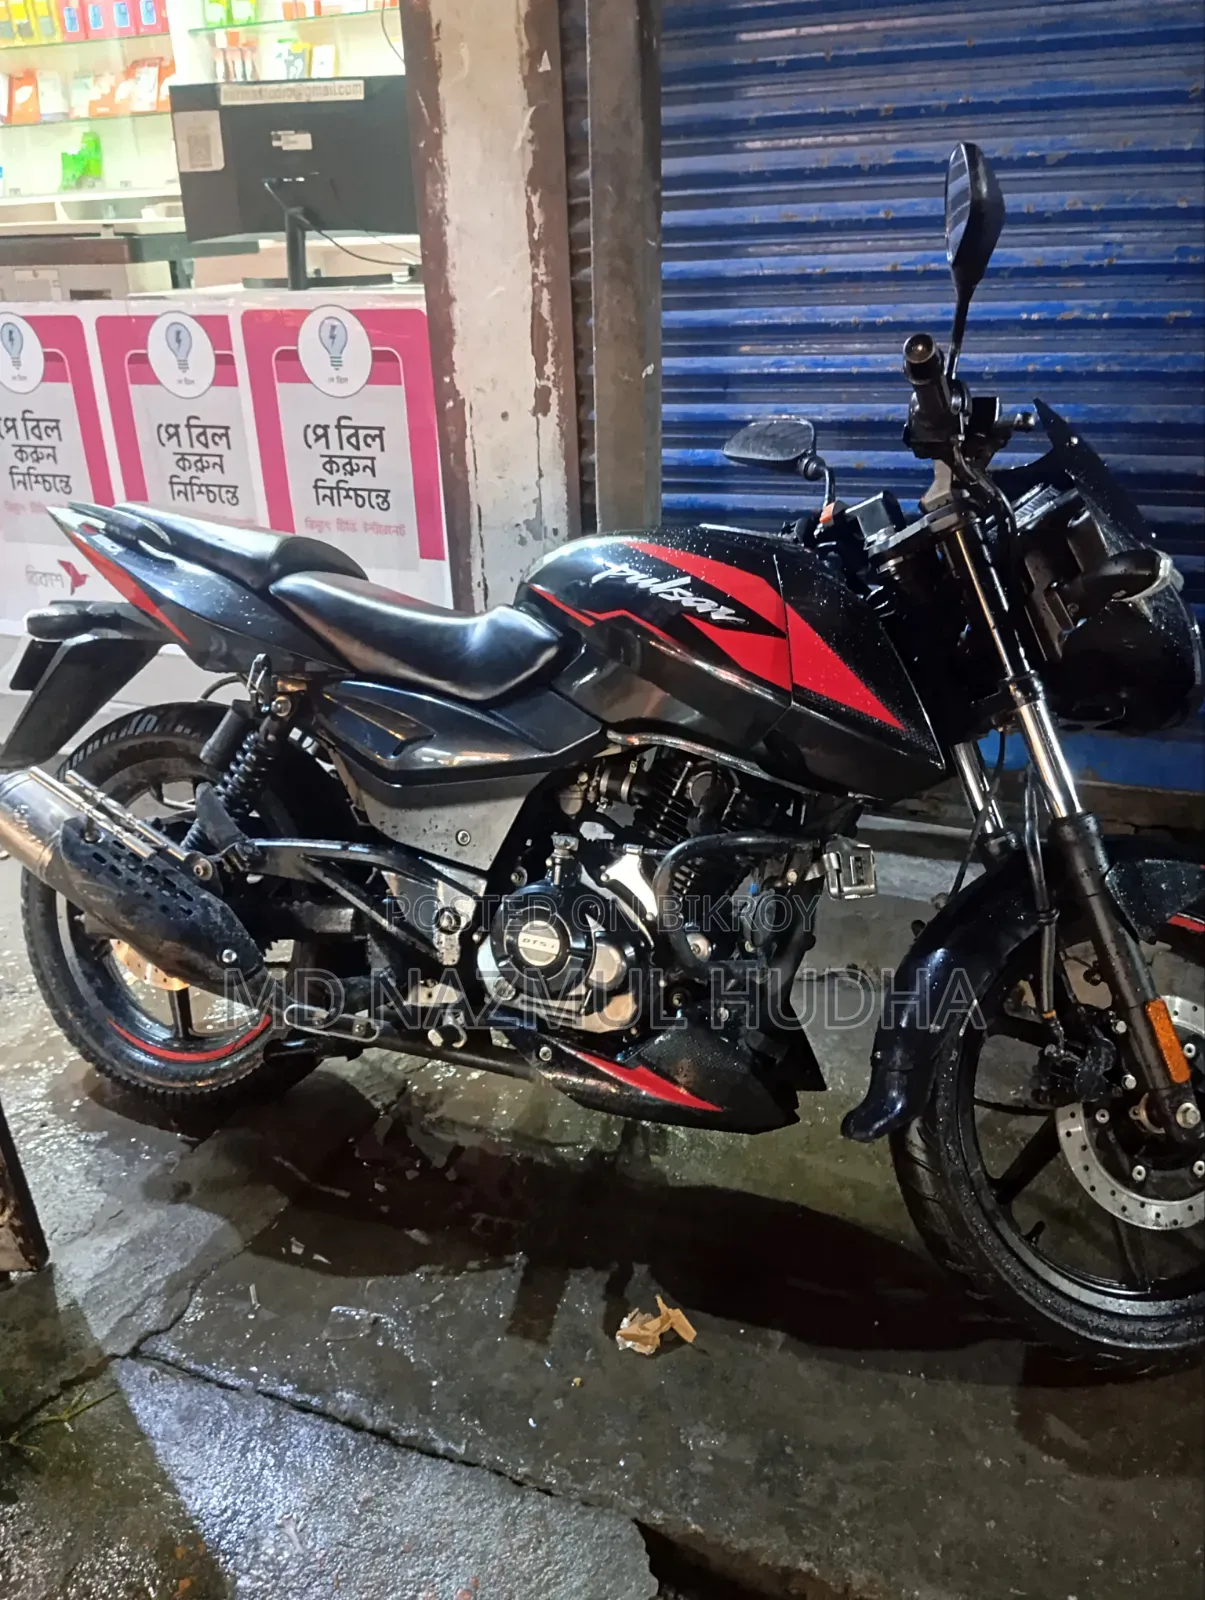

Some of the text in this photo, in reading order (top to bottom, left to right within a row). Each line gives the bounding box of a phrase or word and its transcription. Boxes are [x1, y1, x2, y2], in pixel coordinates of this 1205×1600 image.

[21, 409, 62, 441] বিল
[157, 415, 231, 450] পে বিল
[303, 415, 385, 452] পে বিল
[12, 443, 58, 465] করুন
[173, 452, 225, 474] করুন
[320, 454, 376, 477] করুন
[9, 465, 72, 495] নিশ্চিন্তে
[169, 475, 239, 506] নিশ্চিন্তে
[313, 478, 391, 511] নিশ্চিন্তে
